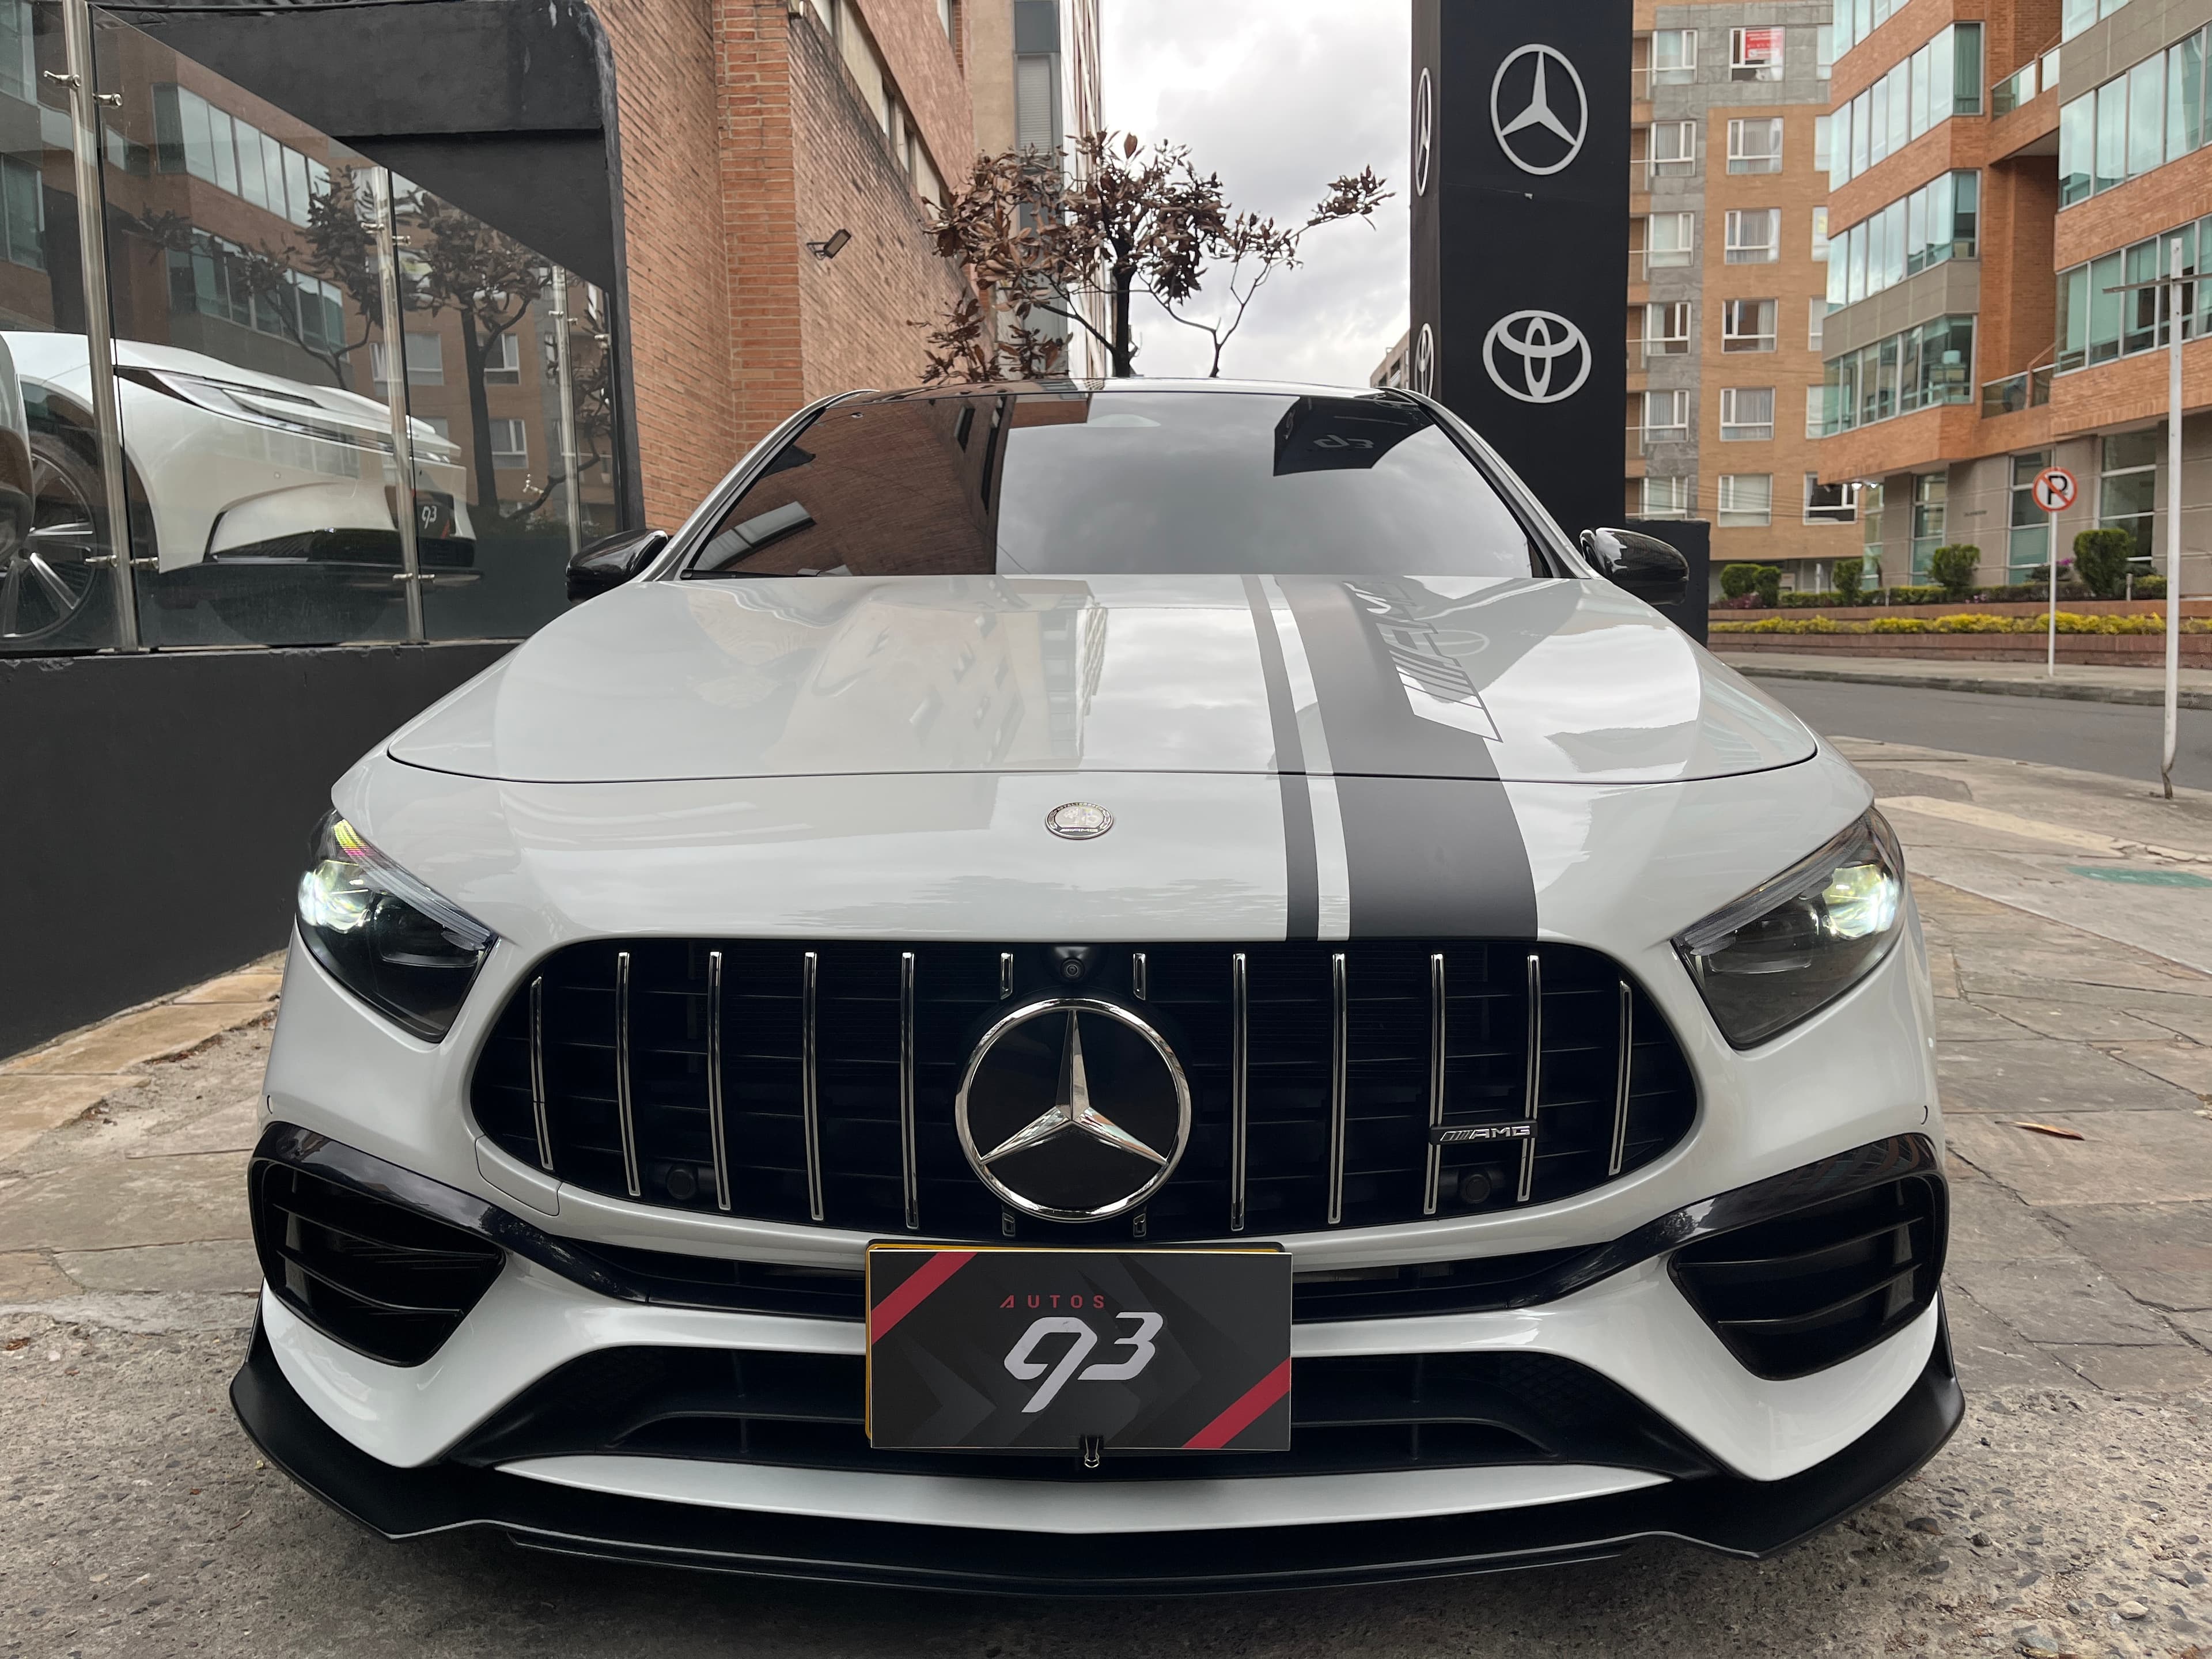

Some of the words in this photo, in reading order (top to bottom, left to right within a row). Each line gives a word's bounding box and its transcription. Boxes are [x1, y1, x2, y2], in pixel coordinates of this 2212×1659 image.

[2048, 475, 2067, 505] P
[422, 505, 437, 529] 93
[999, 1294, 1105, 1309] AUTOS
[1003, 1311, 1164, 1413] 93
